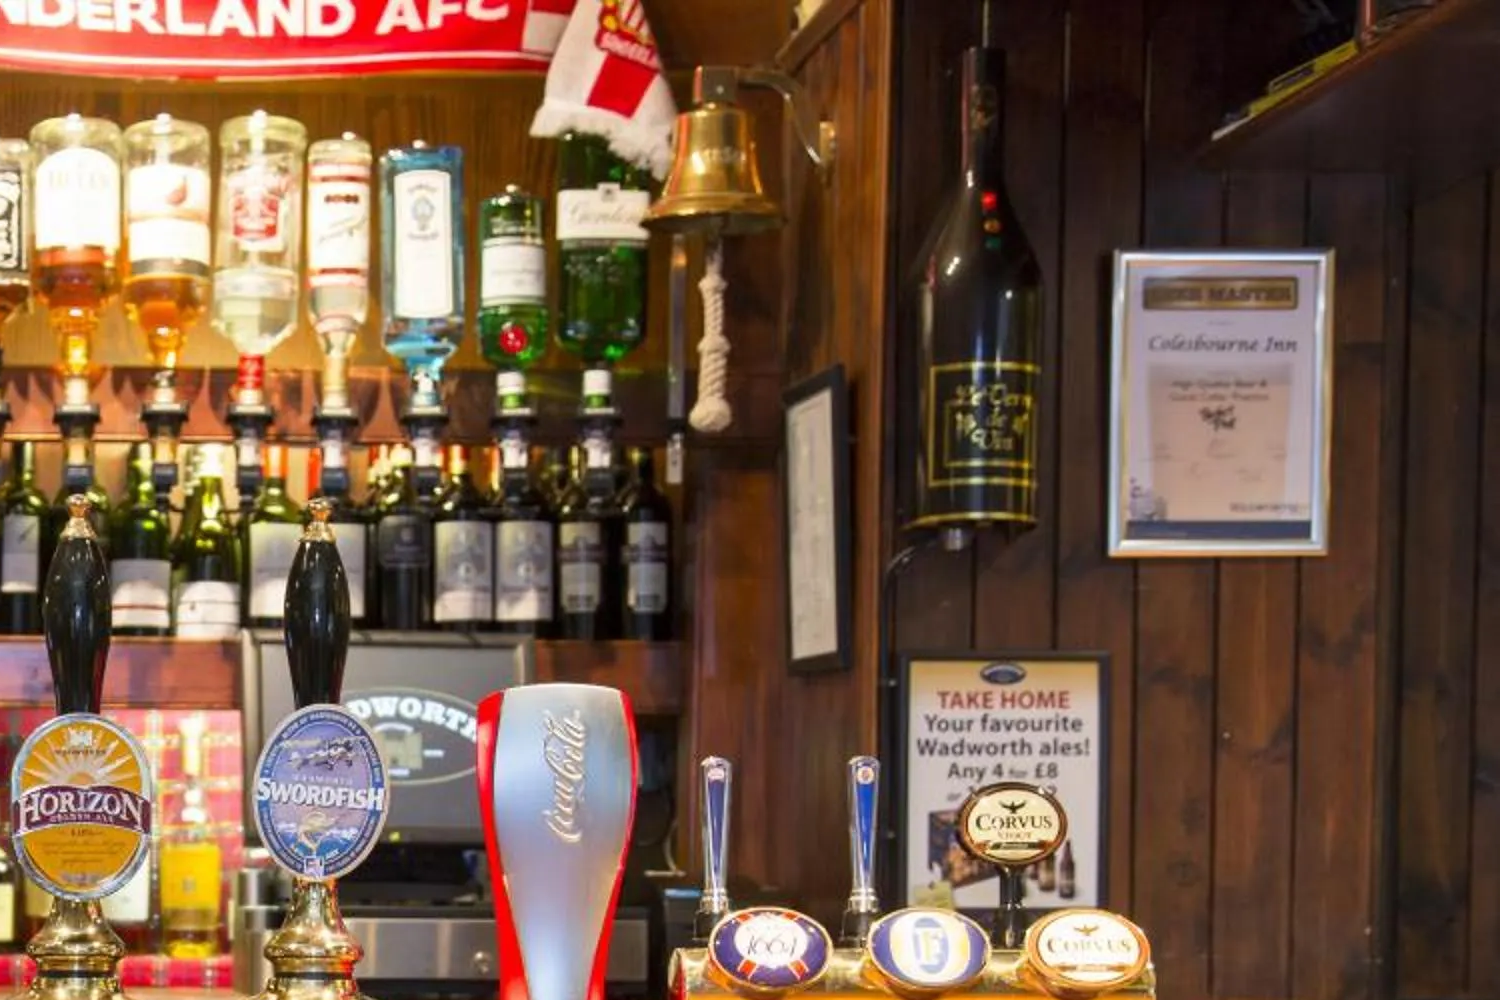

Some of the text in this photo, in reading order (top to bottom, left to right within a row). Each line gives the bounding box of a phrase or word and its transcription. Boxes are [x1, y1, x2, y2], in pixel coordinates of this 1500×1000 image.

[373, 0, 509, 35] AFC
[1264, 336, 1298, 352] Inn
[937, 691, 1071, 709] TAKE HOME
[346, 696, 477, 742] DWORT
[924, 713, 1083, 732] Your favourite
[917, 737, 1090, 756] Wadworth ales!
[947, 763, 987, 783] Any
[991, 763, 1004, 778] 4
[1035, 763, 1058, 779] £8
[257, 777, 385, 811] SWORDFISH
[19, 790, 145, 833] HORIZON
